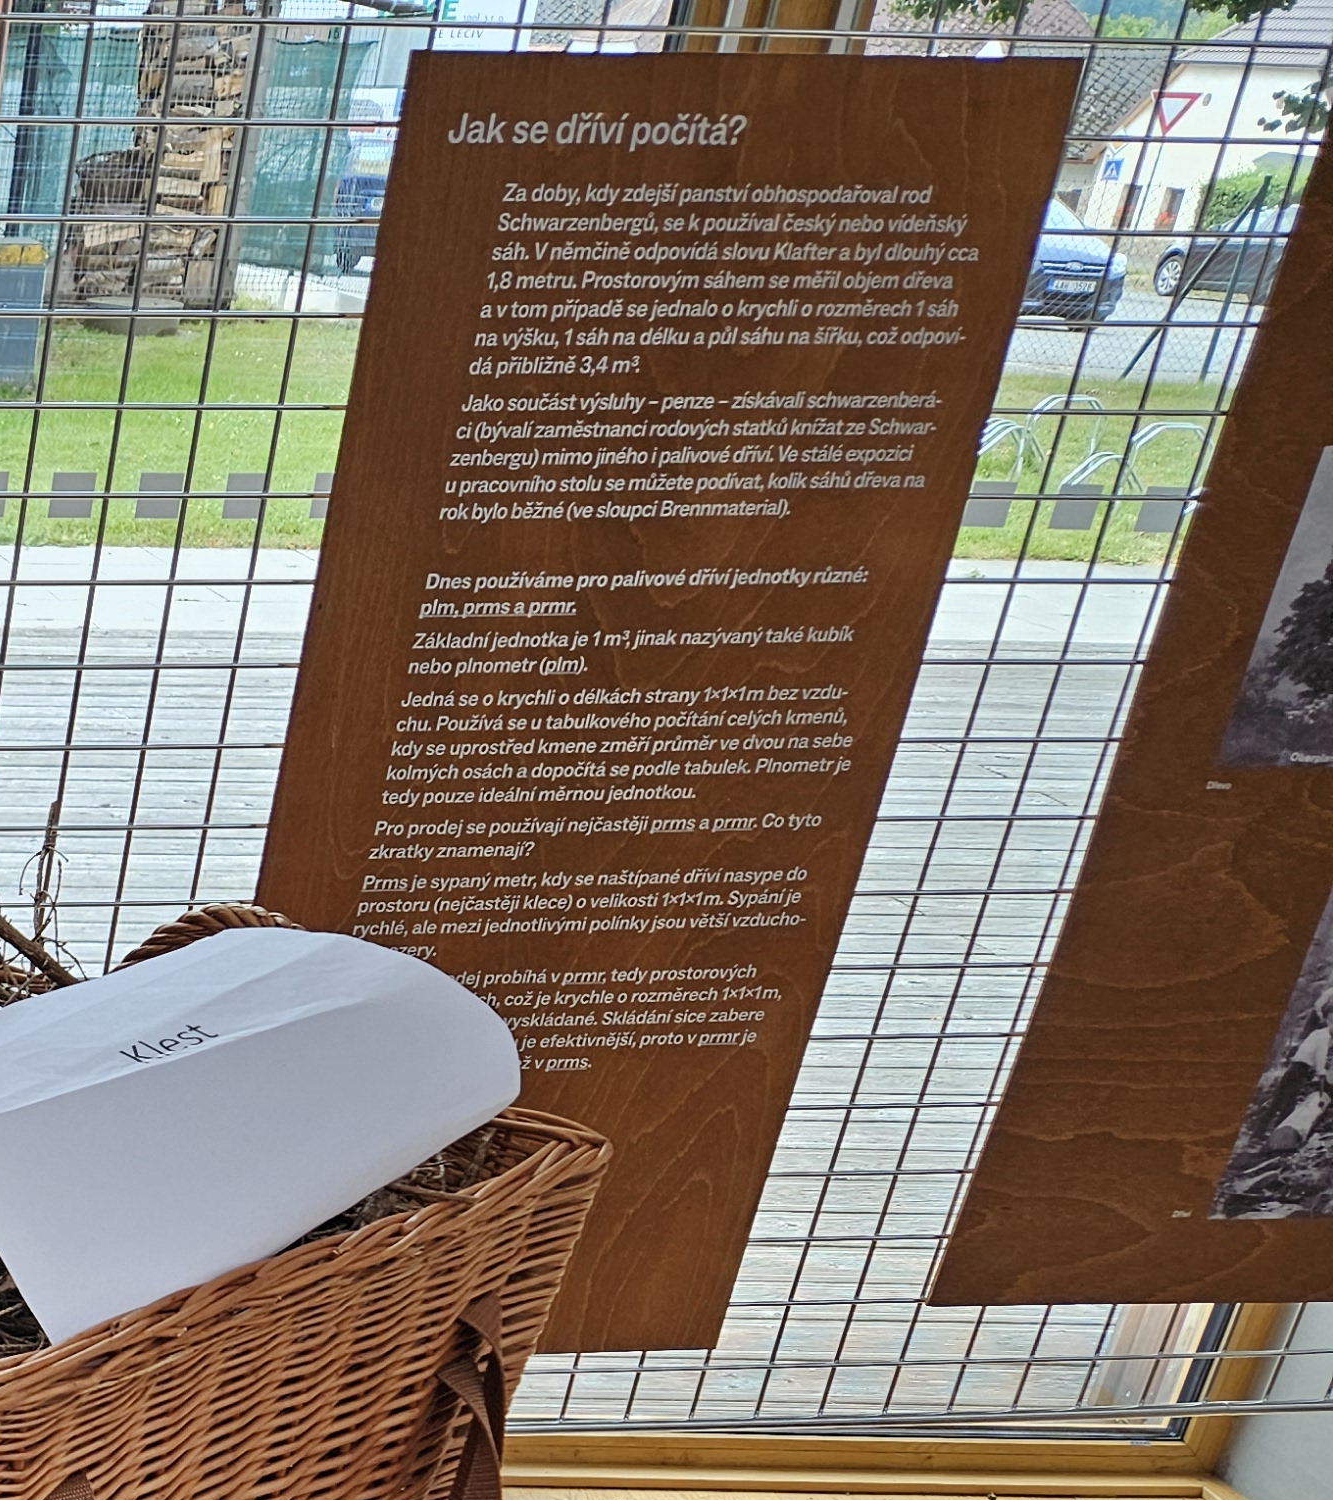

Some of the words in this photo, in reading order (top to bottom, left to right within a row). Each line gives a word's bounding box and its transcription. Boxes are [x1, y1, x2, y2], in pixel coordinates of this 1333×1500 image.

[449, 114, 505, 142] Jak
[513, 122, 547, 142] se
[557, 113, 628, 143] dříví
[630, 114, 746, 151] počítá?
[503, 184, 526, 201] Za
[532, 184, 580, 205] doby,
[586, 184, 620, 205] kdy
[622, 184, 678, 206] zdejší
[679, 184, 750, 206] panství
[752, 185, 898, 206] obhospodařoval
[901, 186, 932, 203] rod
[499, 213, 657, 235] Schwarzenbergů,
[664, 219, 684, 230] se
[689, 214, 699, 230] k
[703, 214, 779, 234] používal
[784, 214, 835, 235] český
[839, 215, 883, 231] nebo
[889, 215, 967, 236] vídeňský
[488, 272, 512, 292] 1,8
[516, 273, 576, 288] metru.
[582, 271, 698, 292] Prostorovým
[704, 271, 764, 288] sáhem
[769, 276, 789, 288] se
[794, 271, 840, 287] měřil
[844, 272, 898, 292] objem
[904, 272, 952, 288] dřeva
[426, 574, 471, 589] Dnes
[475, 572, 573, 592] používáme
[577, 576, 607, 591] pro
[611, 569, 685, 590] palivové
[690, 569, 730, 585] dříví
[732, 569, 812, 589] jednotky
[813, 567, 868, 583] různé:
[397, 717, 430, 731] chu.
[437, 715, 502, 730] Používá
[508, 719, 526, 730] se
[532, 719, 541, 729] u
[547, 713, 650, 729] tabulkového
[654, 711, 726, 731] počítání
[728, 710, 781, 729] celých
[786, 708, 846, 725] kmenů,
[383, 789, 420, 807] tedy
[423, 793, 474, 806] pouze
[479, 787, 536, 801] ideální
[539, 785, 604, 800] měrnou
[606, 785, 695, 803] jednotkou.
[375, 822, 403, 835] Pro
[408, 820, 463, 838] prodej
[467, 823, 485, 833] se
[489, 818, 566, 836] používají
[568, 817, 648, 835] nejčastěji
[650, 820, 695, 833] prms
[700, 819, 709, 829] a
[712, 818, 757, 832] prmr.
[763, 814, 783, 827] Co
[789, 814, 821, 830] tyto
[369, 844, 433, 861] zkratky
[437, 842, 534, 859] znamenají?
[602, 1010, 673, 1024] Skládání
[675, 1010, 705, 1022] sice
[709, 1009, 764, 1021] zabere
